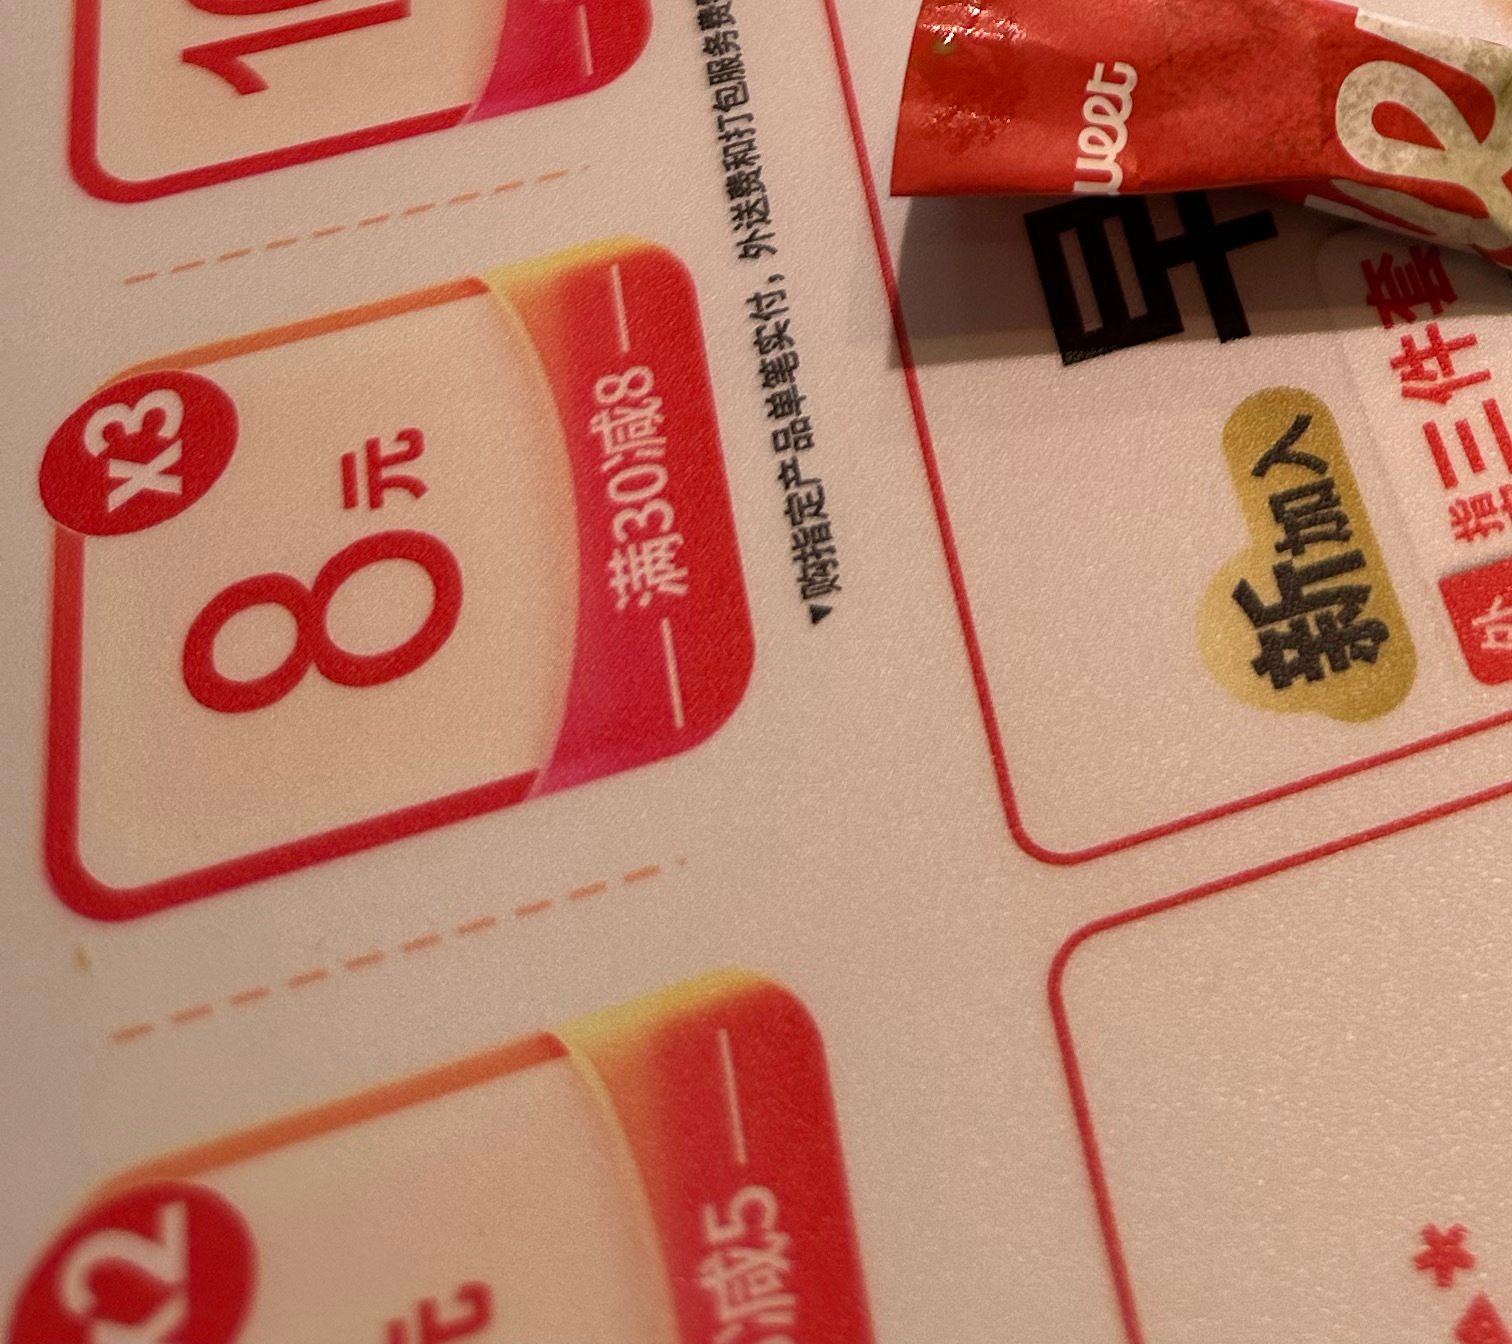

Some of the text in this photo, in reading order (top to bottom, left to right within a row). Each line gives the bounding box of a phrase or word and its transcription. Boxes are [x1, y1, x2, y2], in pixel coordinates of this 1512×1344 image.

[588, 363, 692, 615] 满30减8
[1231, 413, 1391, 692] 新加入
